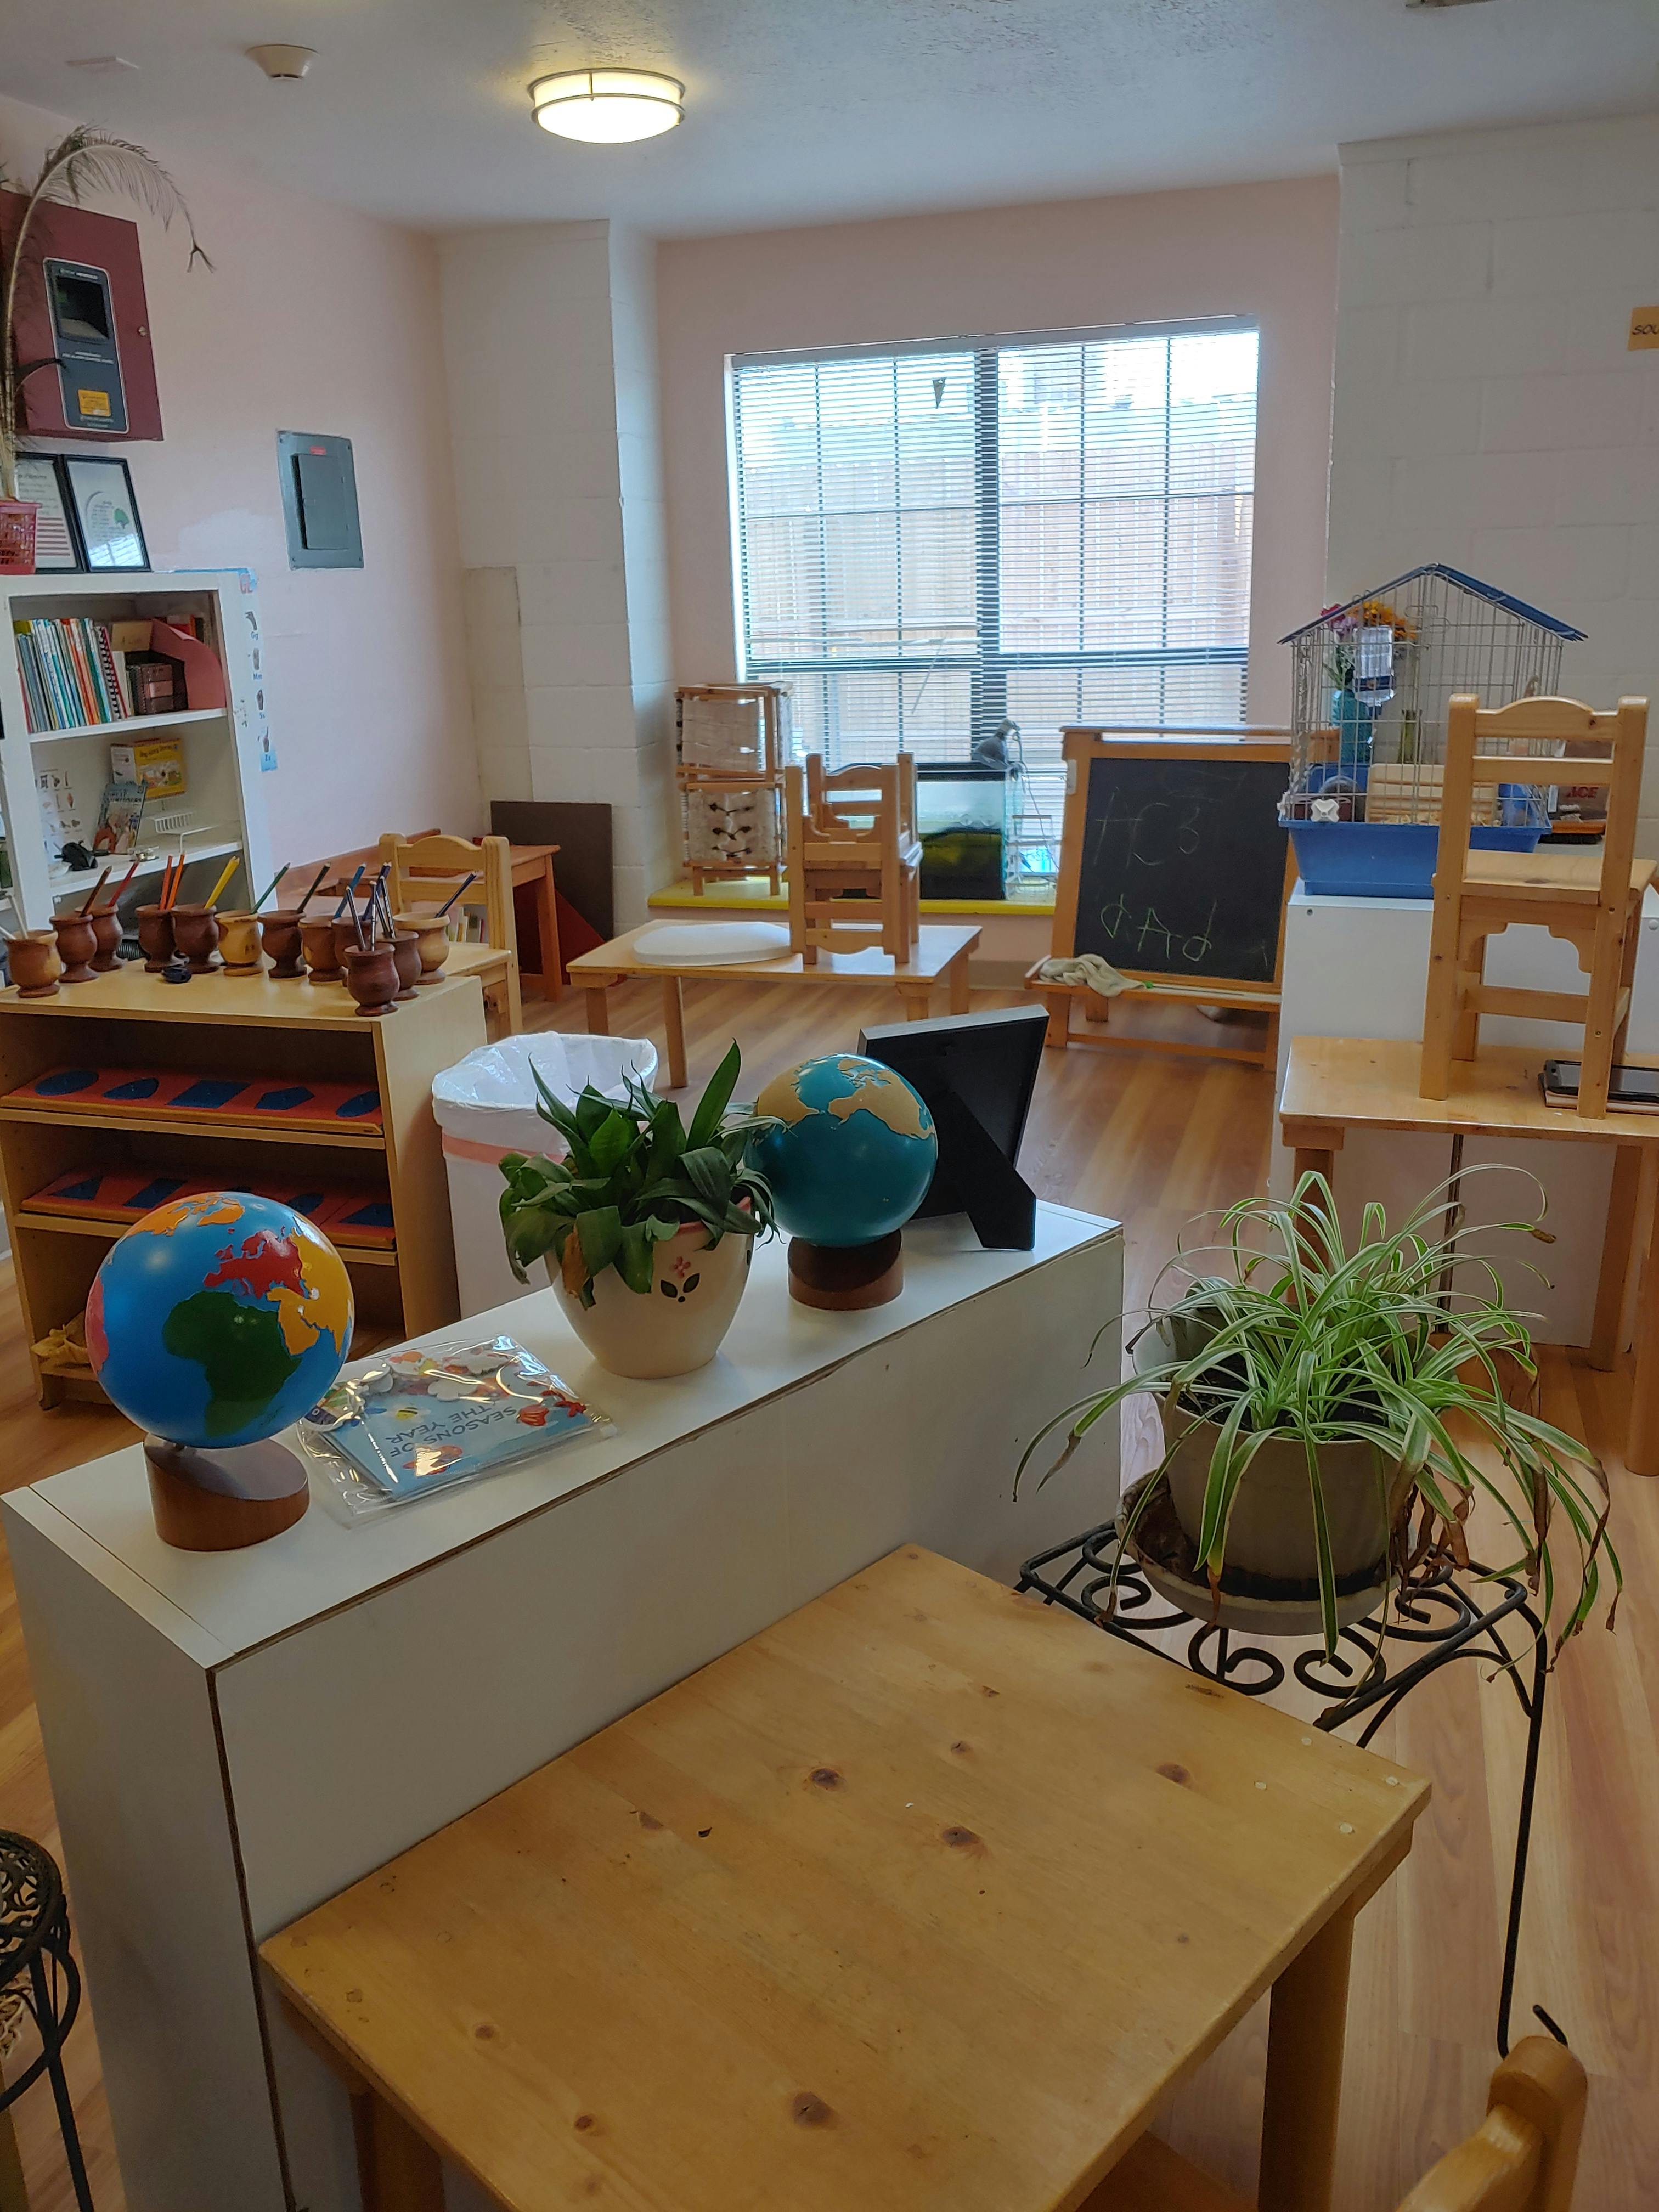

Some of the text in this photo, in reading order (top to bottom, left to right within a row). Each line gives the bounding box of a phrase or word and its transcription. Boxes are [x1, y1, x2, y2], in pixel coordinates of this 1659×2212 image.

[1565, 786, 1599, 798] ACE
[385, 1404, 492, 1444] THE YEAR
[390, 1406, 517, 1457] SEASONS OF
